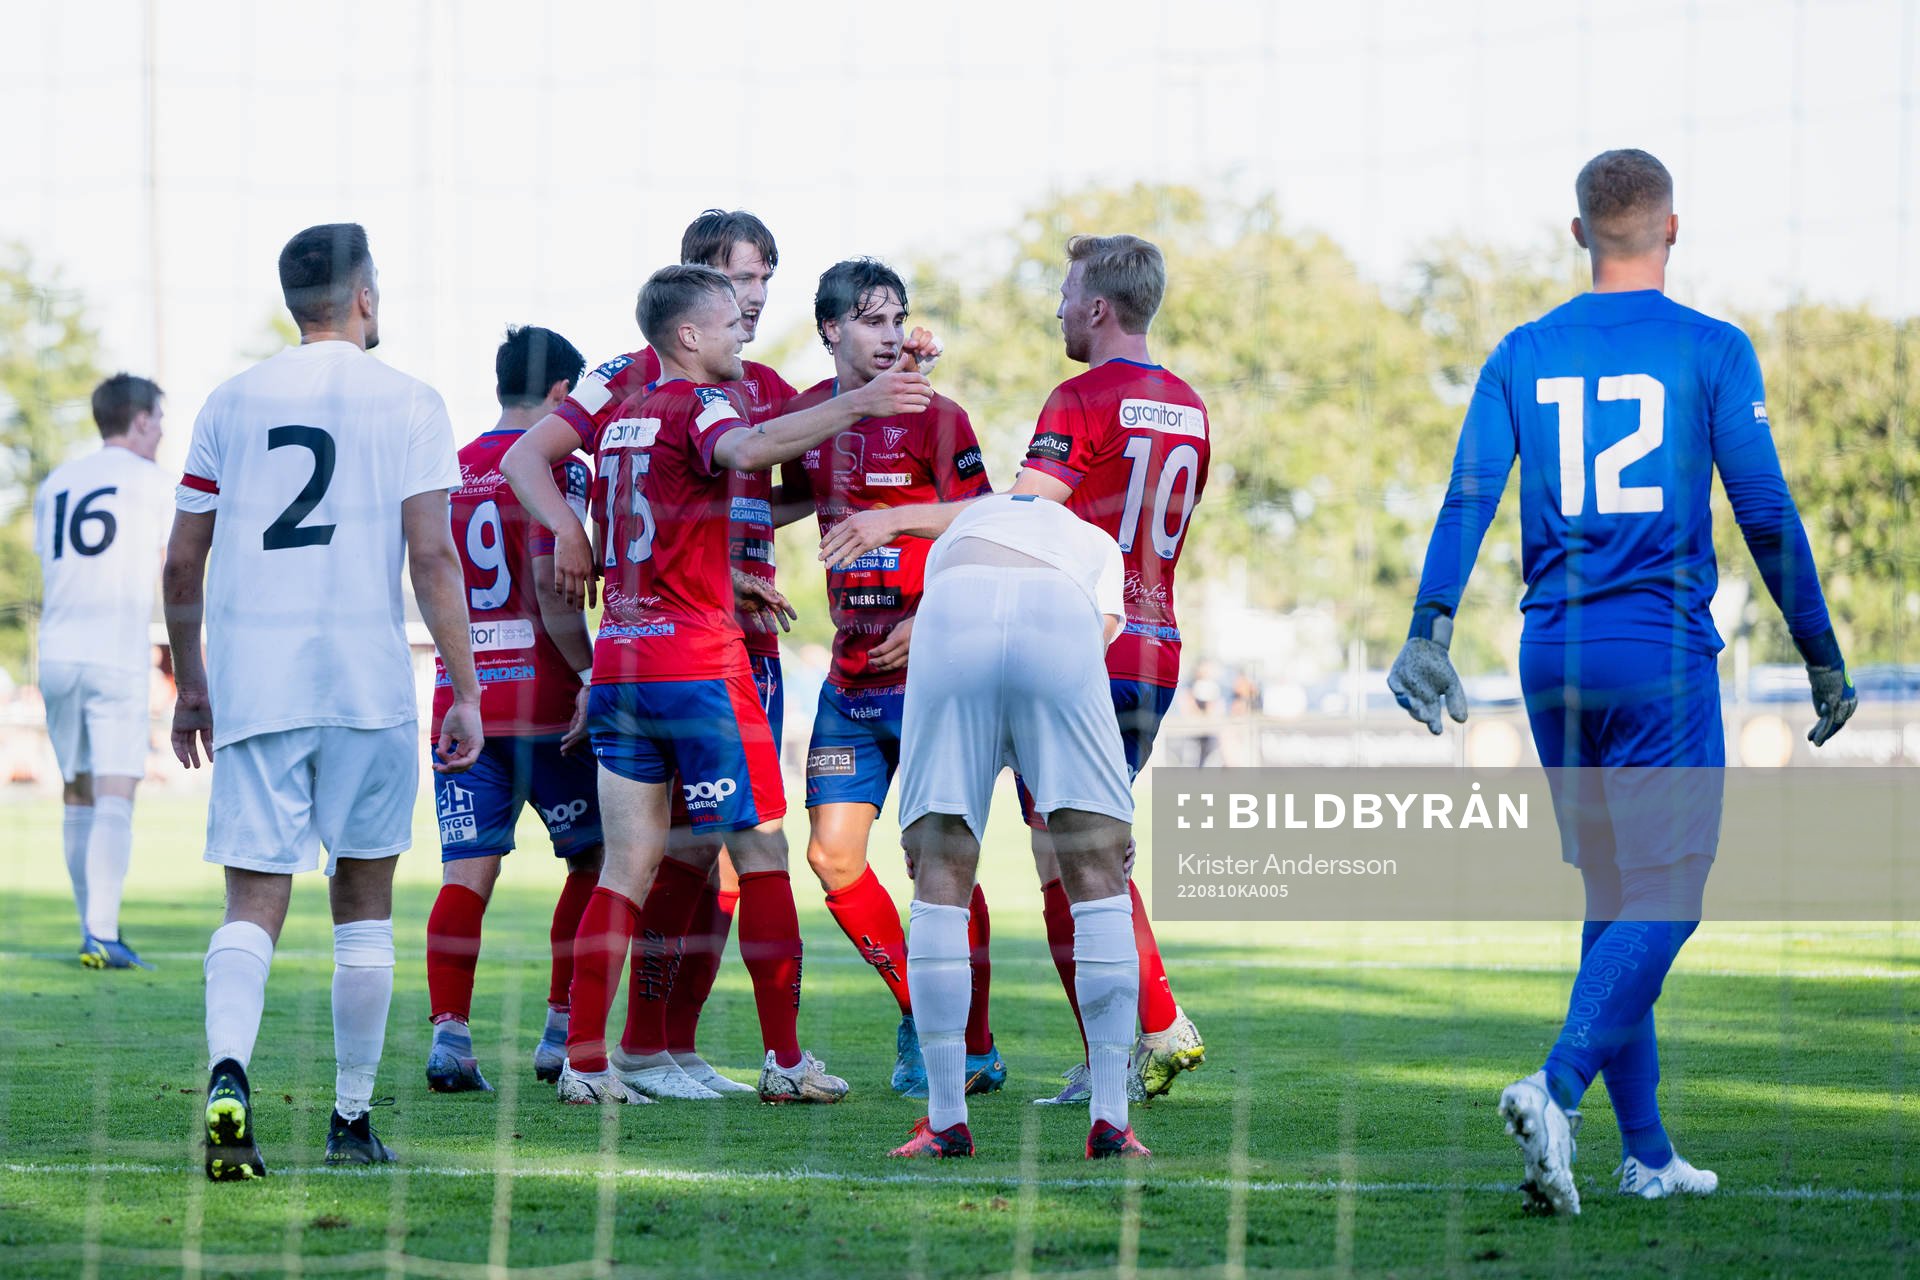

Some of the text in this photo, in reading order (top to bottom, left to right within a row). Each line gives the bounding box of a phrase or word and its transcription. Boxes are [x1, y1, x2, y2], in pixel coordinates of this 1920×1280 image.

[1122, 404, 1184, 428] granitor
[1536, 373, 1665, 516] 12
[263, 424, 337, 551] 2
[1119, 435, 1201, 560] 10
[53, 486, 118, 560] 16
[882, 558, 896, 569] AB
[850, 706, 883, 719] Tvååker
[440, 816, 474, 833] BYGG
[447, 829, 465, 842] AB
